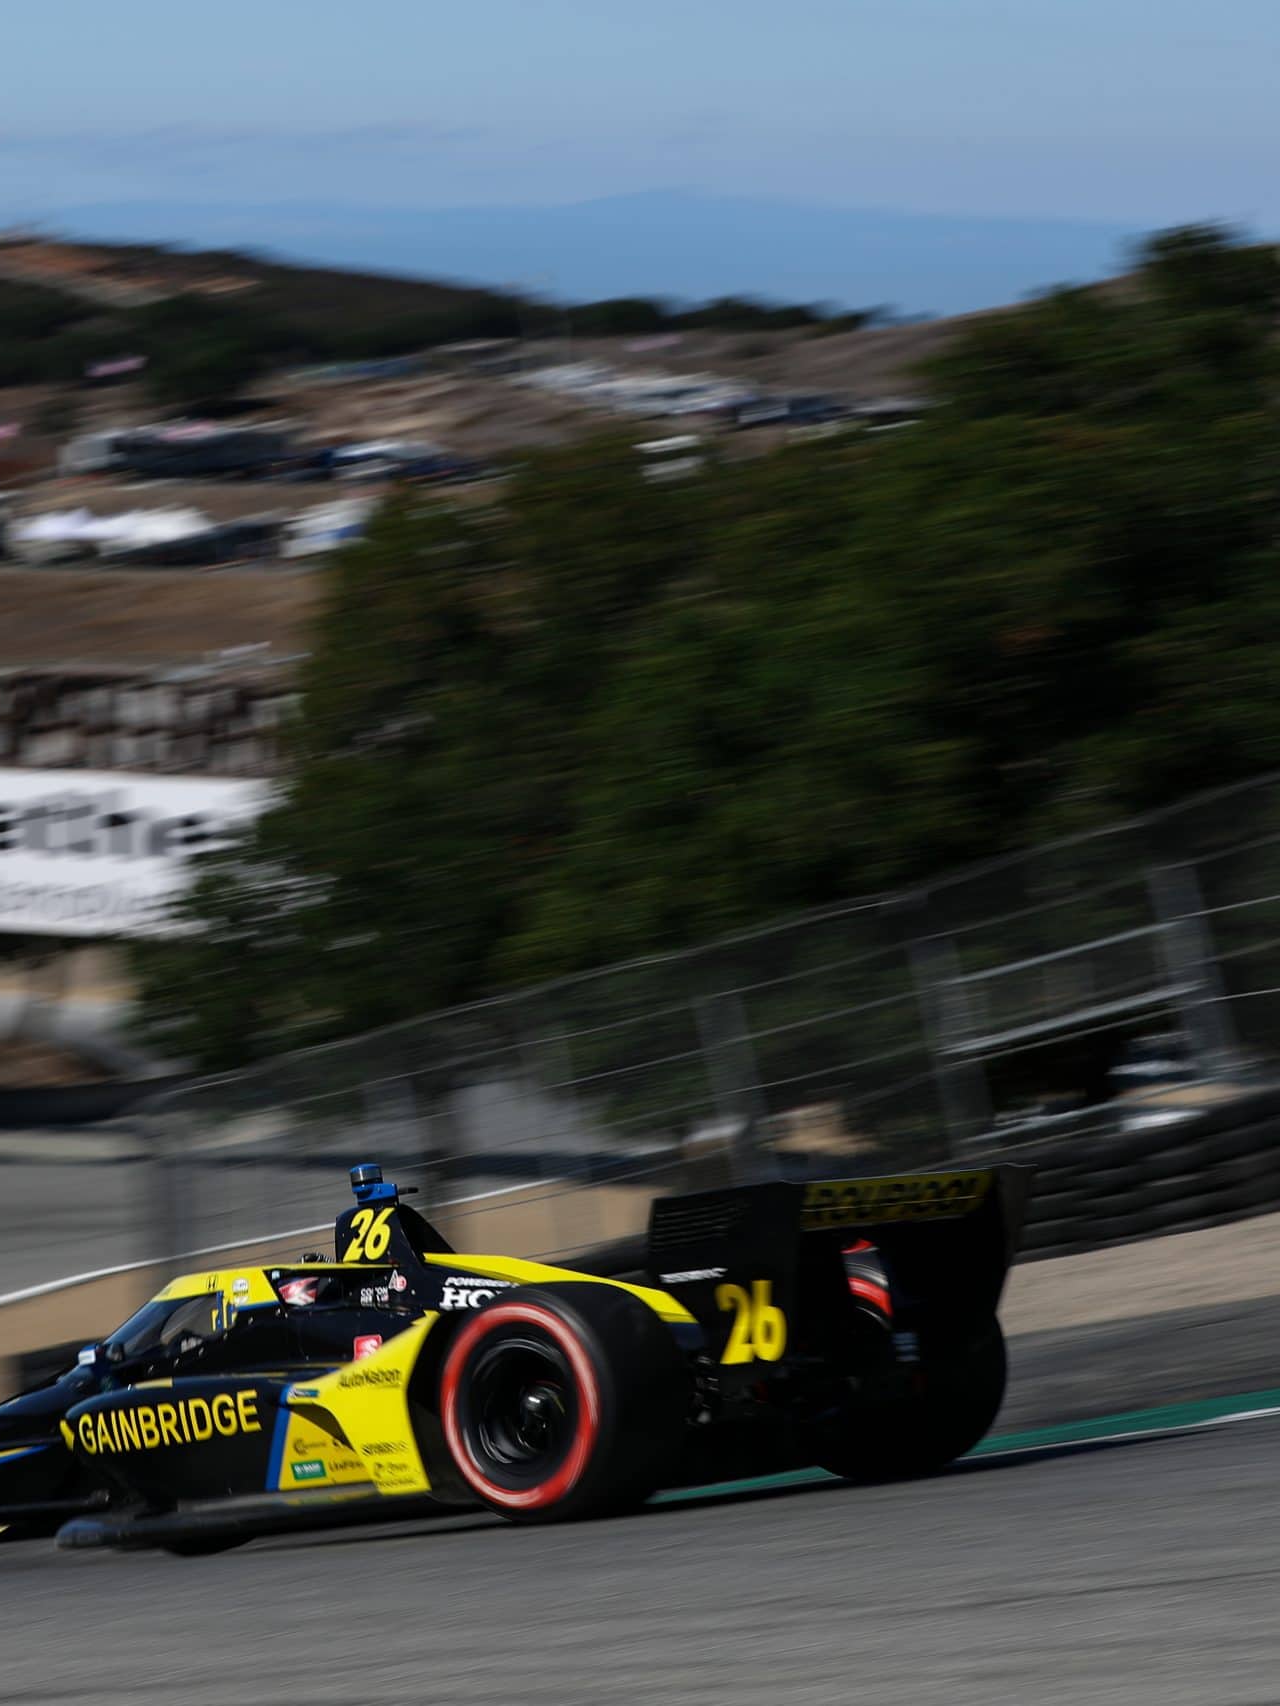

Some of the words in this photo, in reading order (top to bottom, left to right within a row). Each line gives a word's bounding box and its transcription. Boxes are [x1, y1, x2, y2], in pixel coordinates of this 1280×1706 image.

[343, 1207, 395, 1263] 26
[714, 1279, 787, 1365] 26
[78, 1389, 262, 1454] GAINBRIDGE
